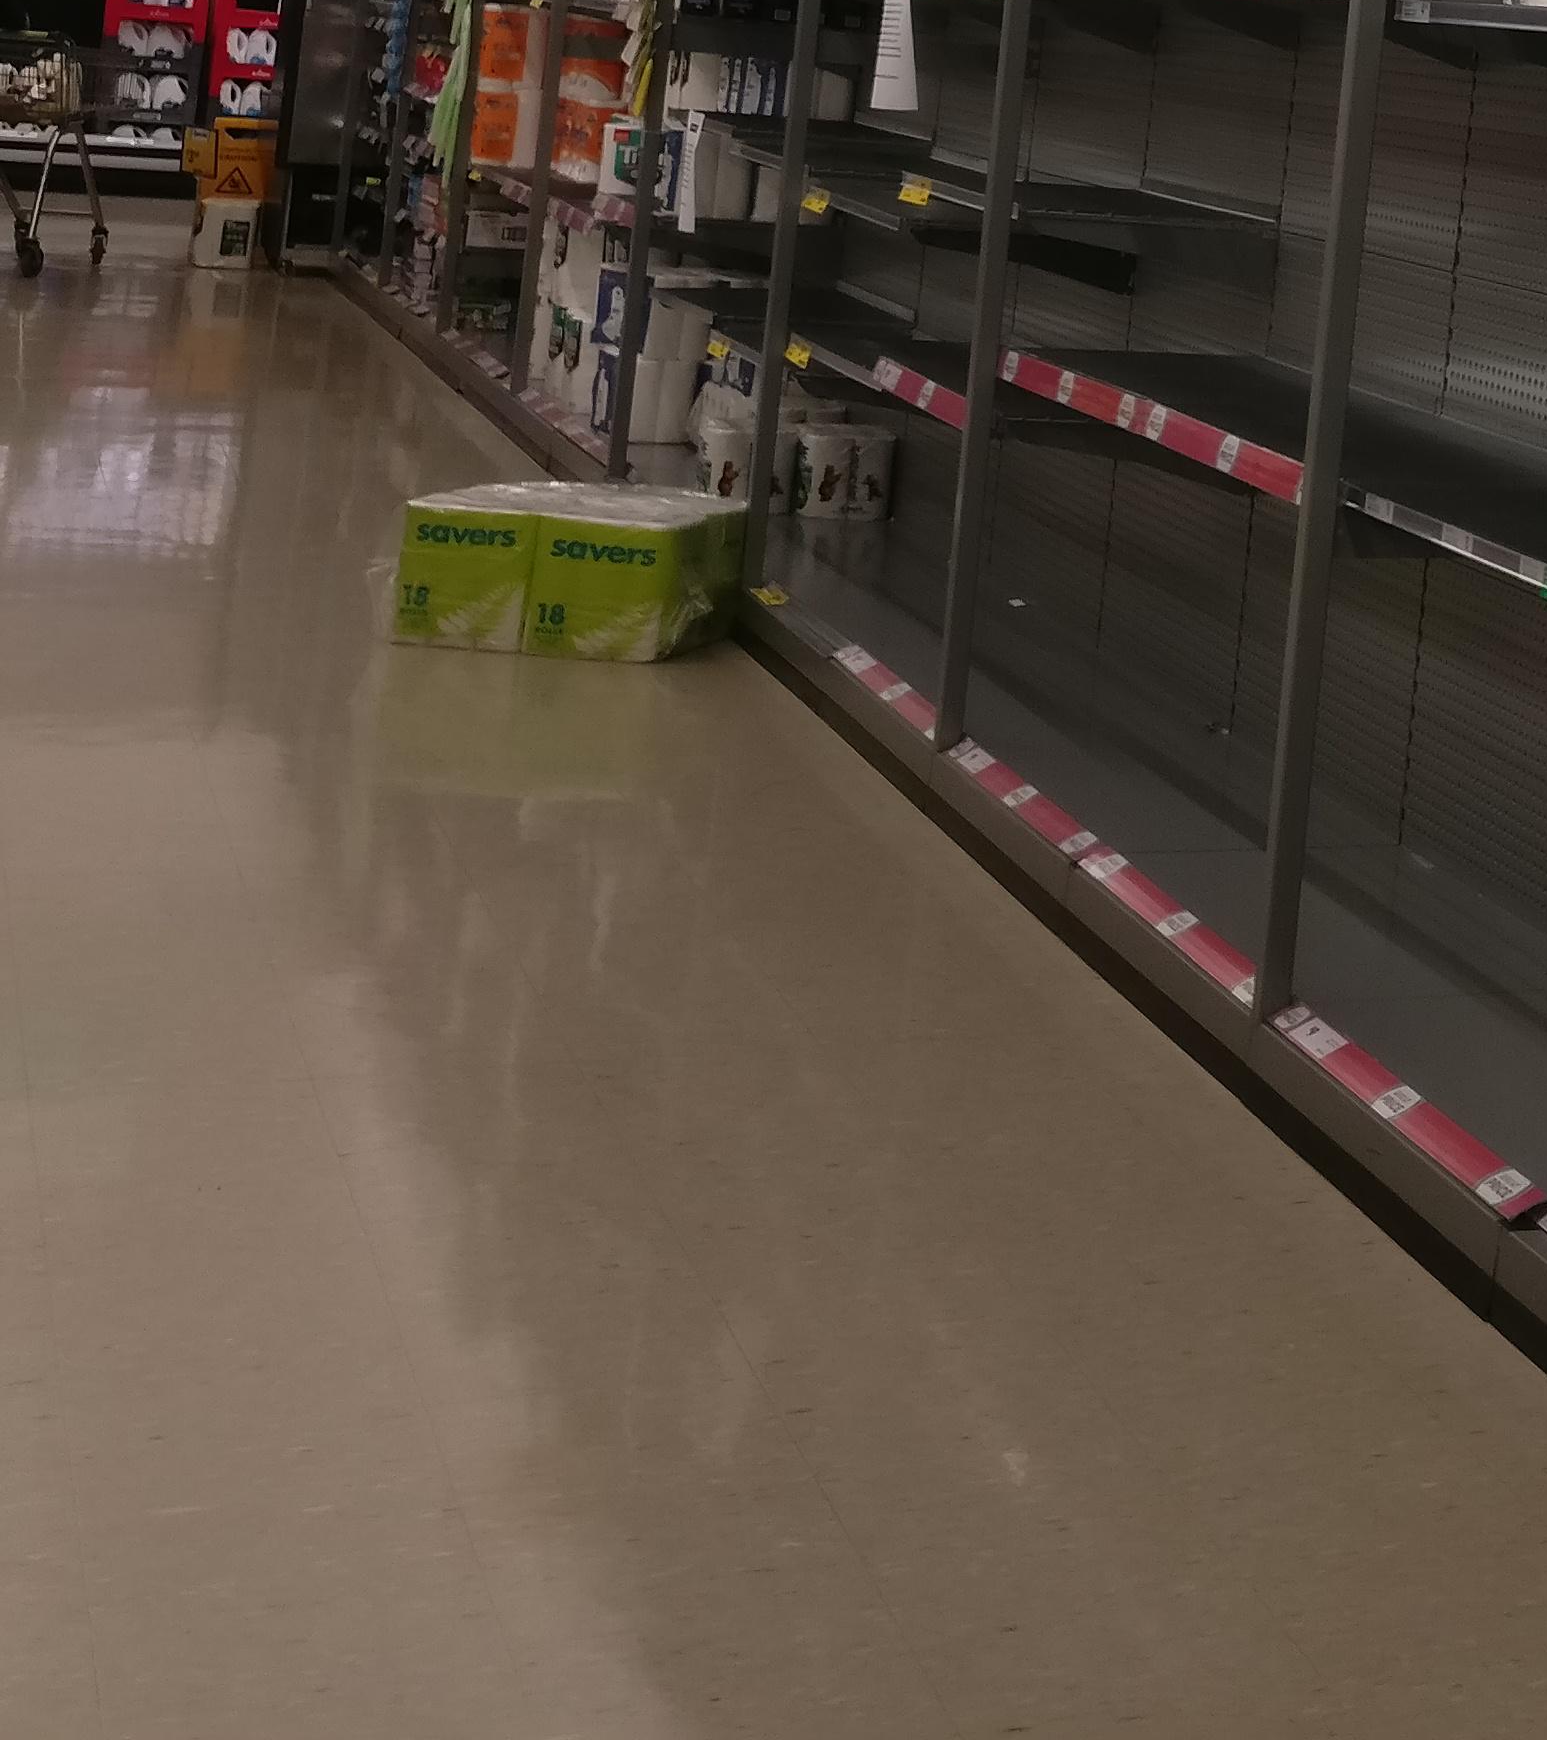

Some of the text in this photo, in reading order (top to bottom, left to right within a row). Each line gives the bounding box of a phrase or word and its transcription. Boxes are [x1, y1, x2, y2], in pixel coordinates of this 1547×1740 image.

[416, 521, 517, 548] savers
[550, 538, 657, 567] savers
[401, 583, 430, 607] 18
[537, 602, 566, 626] 18
